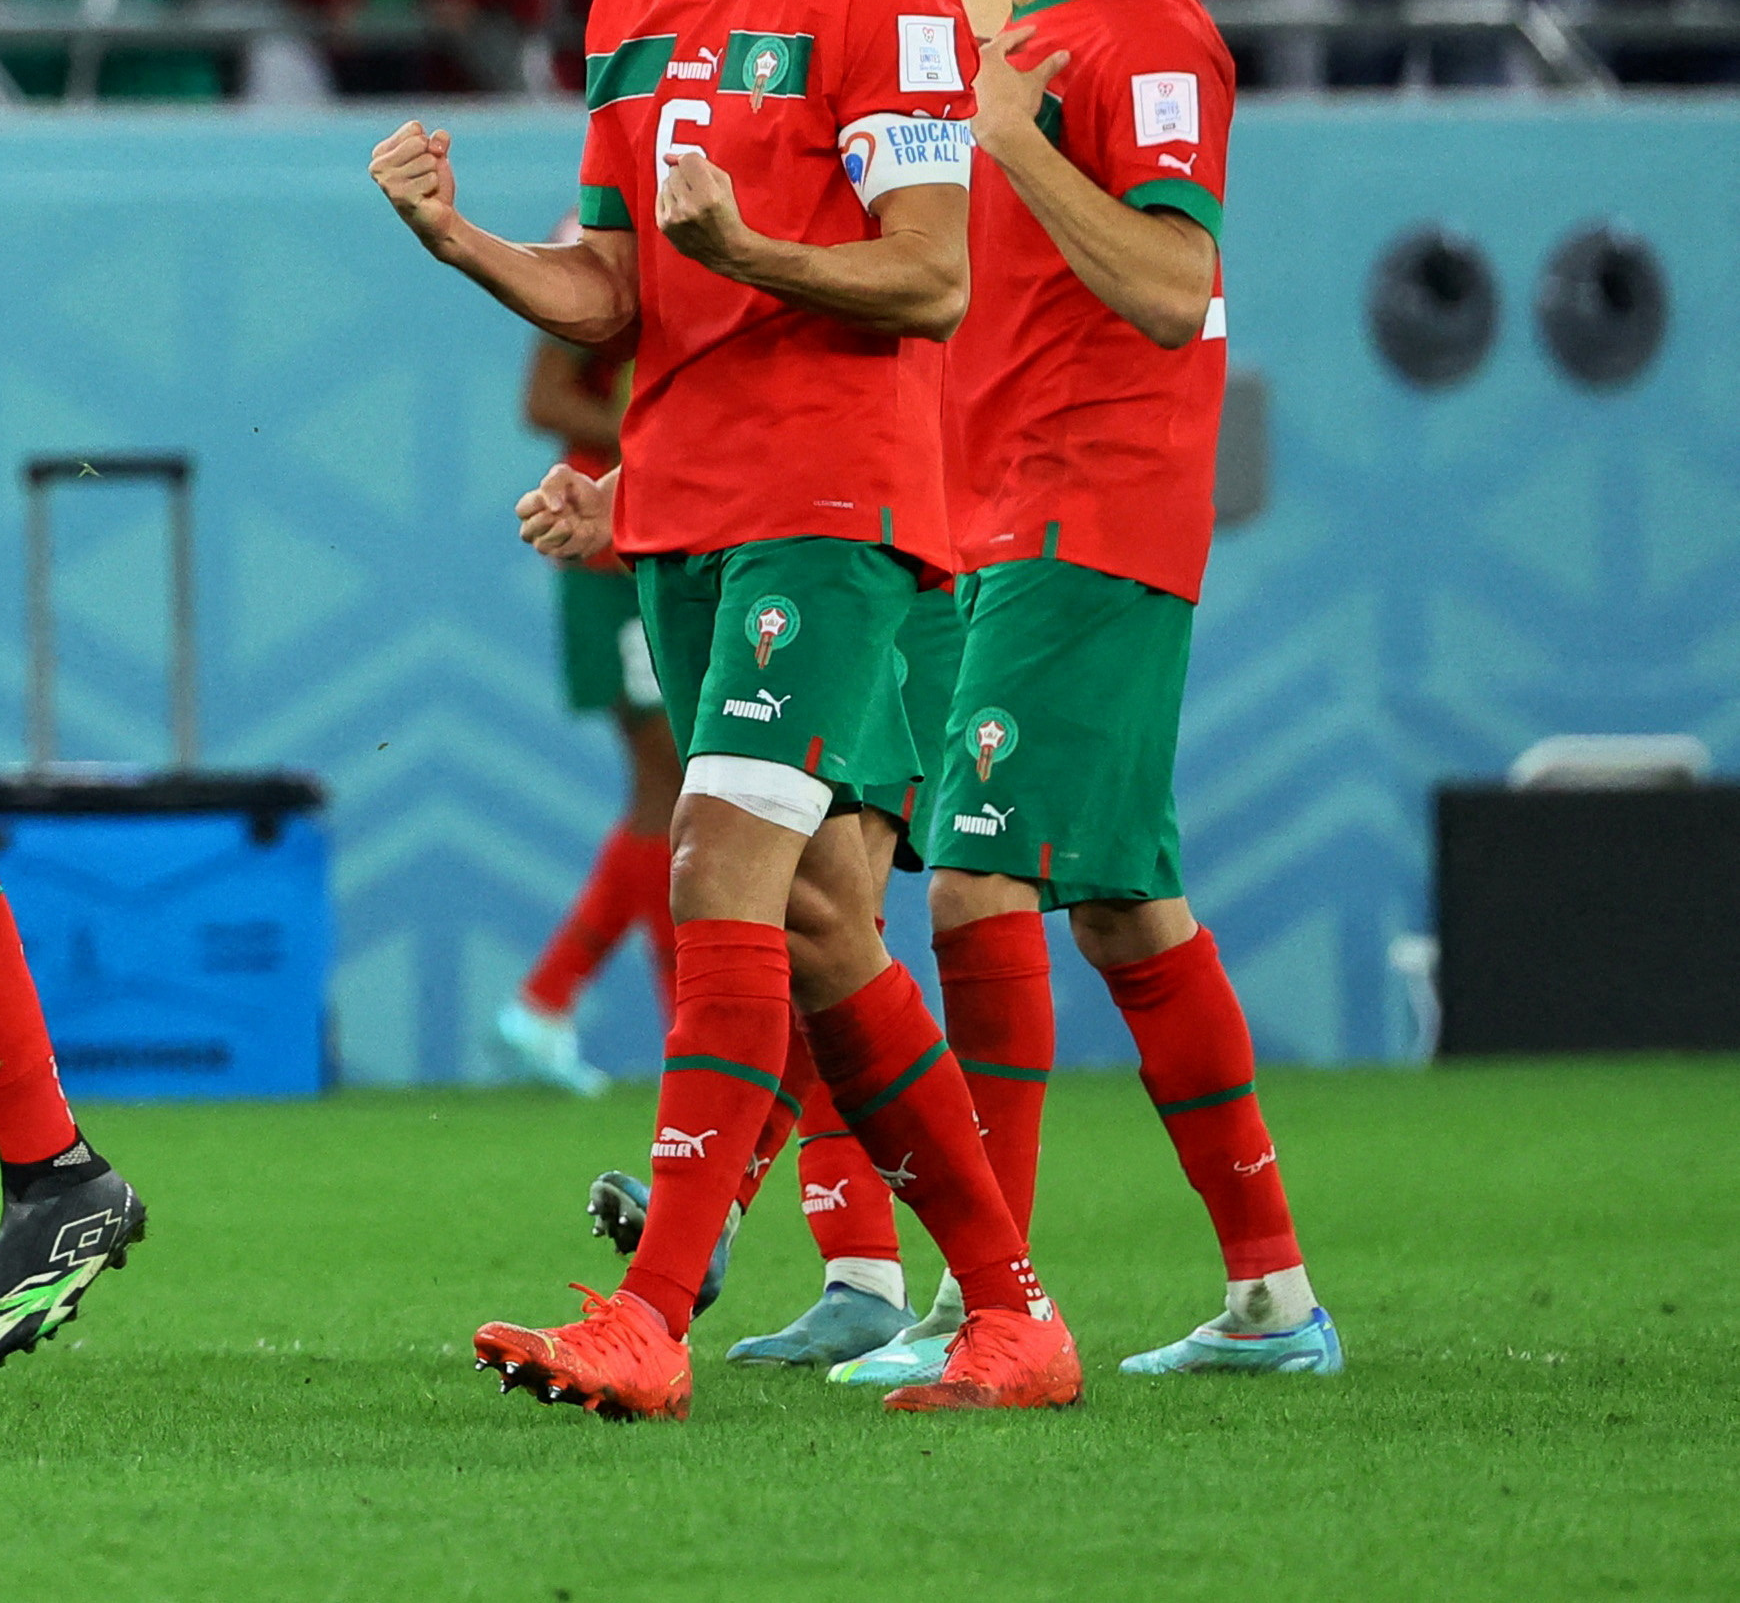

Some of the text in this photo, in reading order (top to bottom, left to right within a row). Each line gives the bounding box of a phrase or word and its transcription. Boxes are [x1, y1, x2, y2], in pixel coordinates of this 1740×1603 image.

[666, 61, 712, 80] PUMA
[895, 143, 960, 165] FOR ALL
[723, 699, 772, 722] PUMA
[953, 814, 998, 837] PUMA
